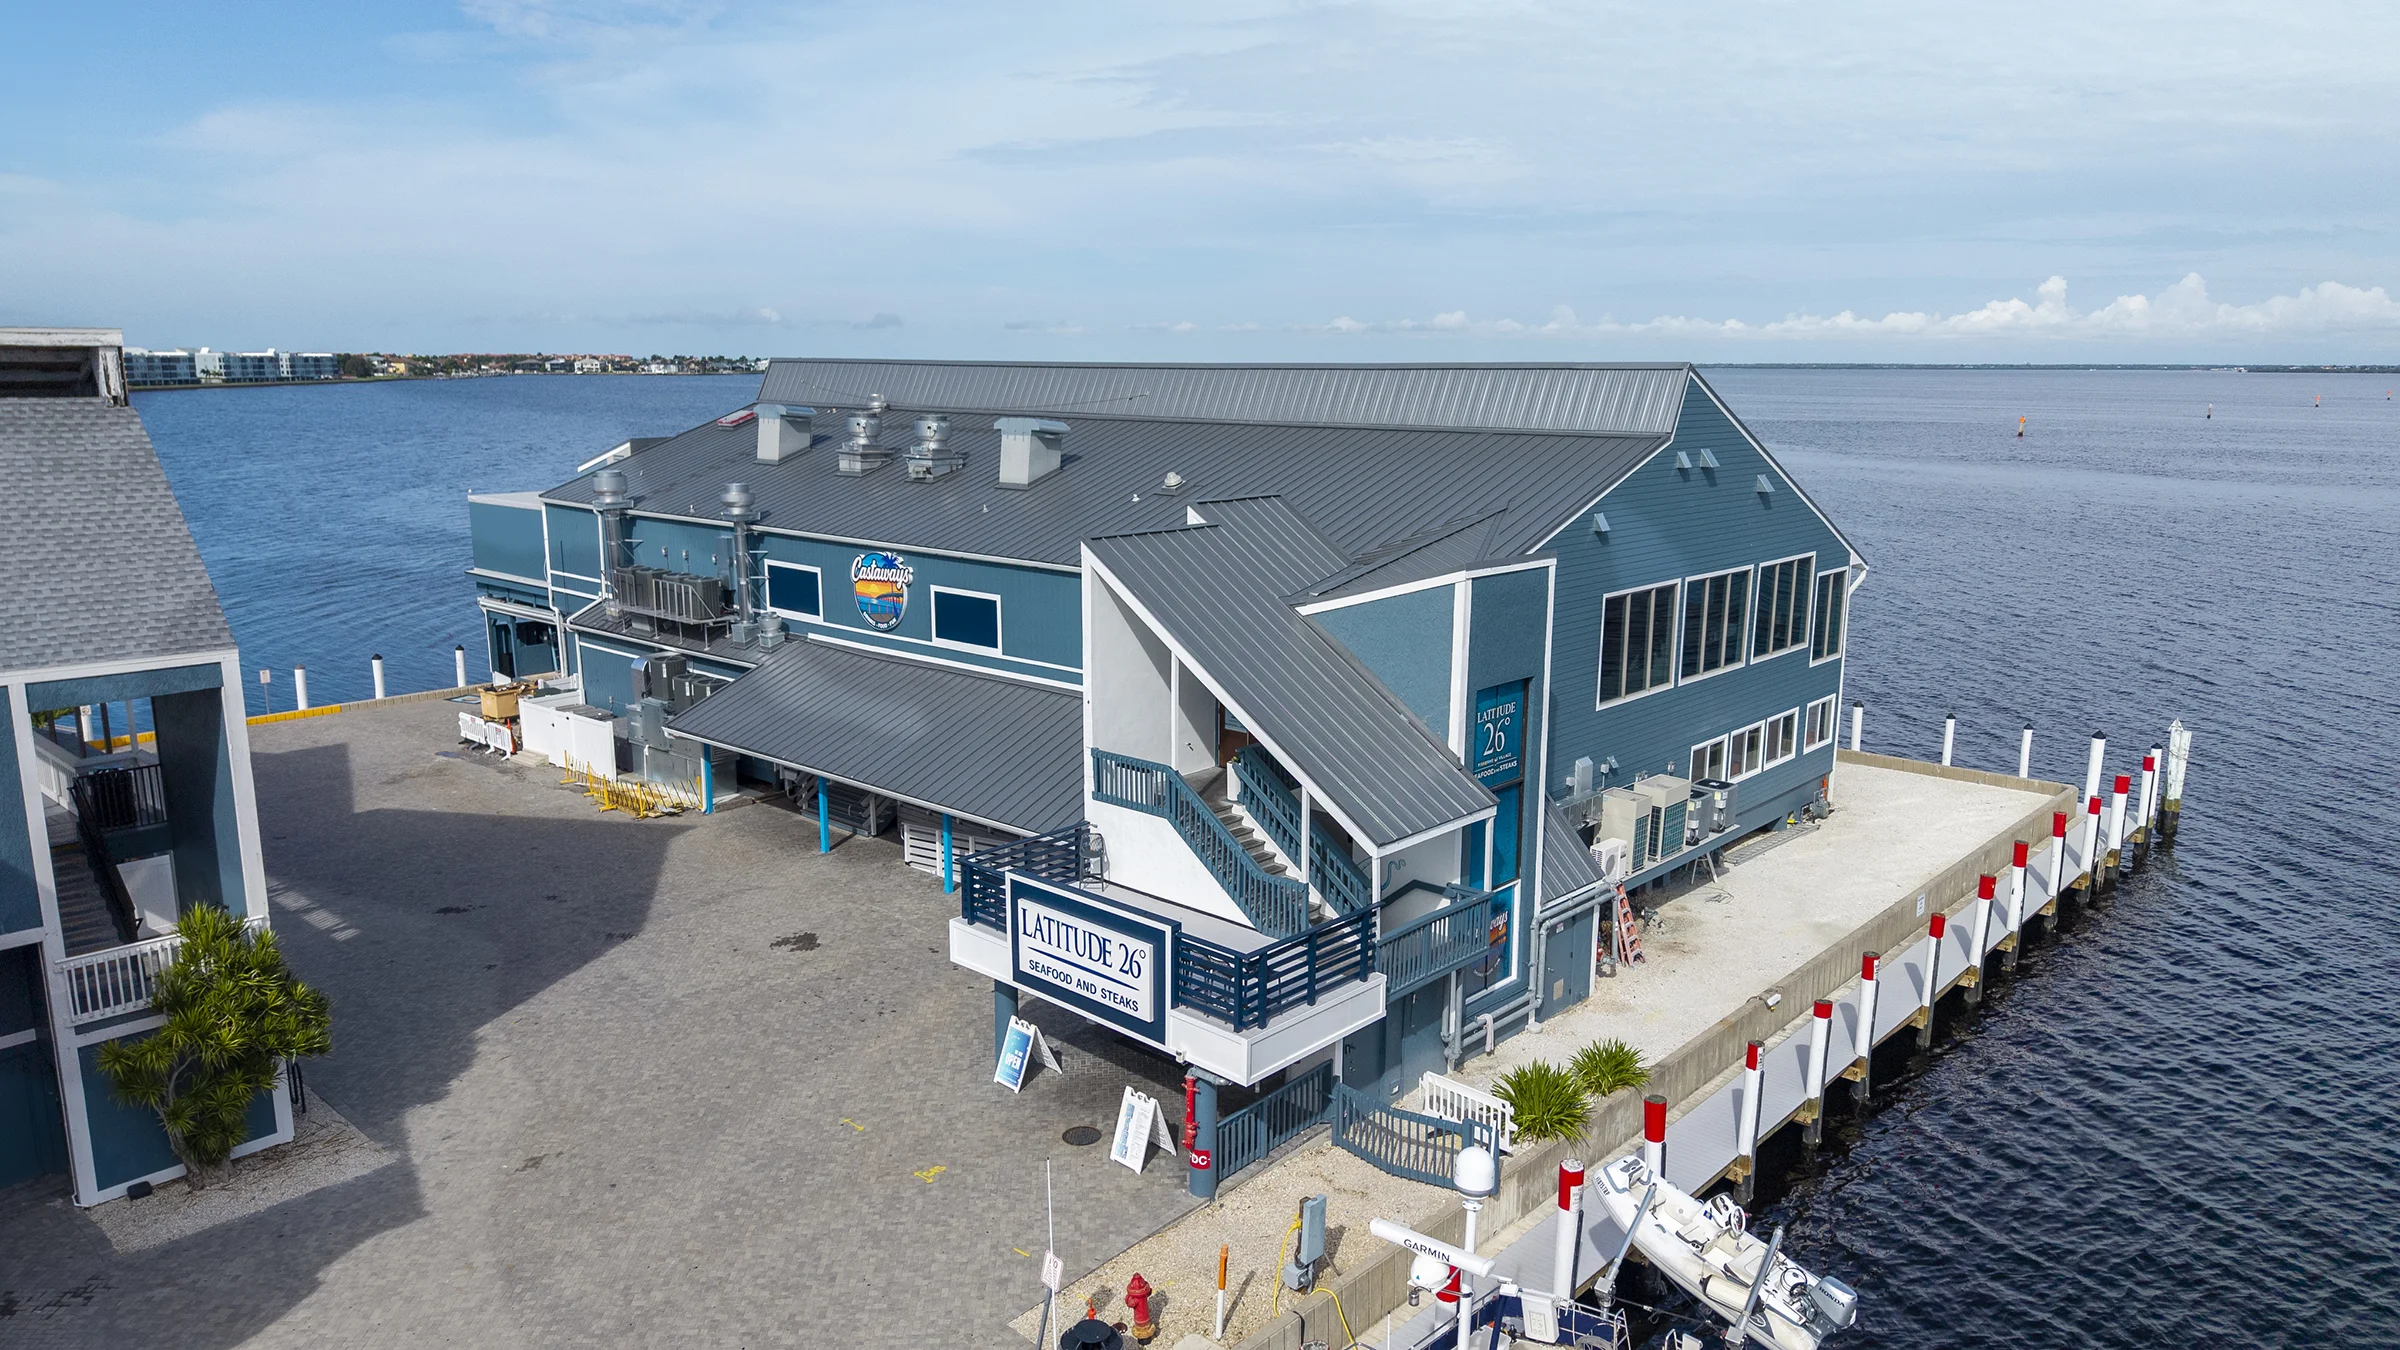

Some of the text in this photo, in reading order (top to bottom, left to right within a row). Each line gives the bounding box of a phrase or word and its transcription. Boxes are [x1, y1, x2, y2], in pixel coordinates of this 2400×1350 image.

[851, 555, 910, 590] Castaways
[1477, 701, 1516, 724] LATITUDE
[1483, 717, 1511, 756] 26°
[1474, 768, 1496, 780] EAFOOD
[1499, 760, 1518, 772] STEAKS
[1021, 907, 1147, 979] LATITUDE 26°
[1029, 959, 1139, 1012] SEAFOOD AND STEAKS
[1005, 1052, 1022, 1070] OPEN
[1190, 1154, 1208, 1166] DC
[1403, 1238, 1450, 1263] GARMIN
[1818, 1286, 1846, 1309] HONDA
